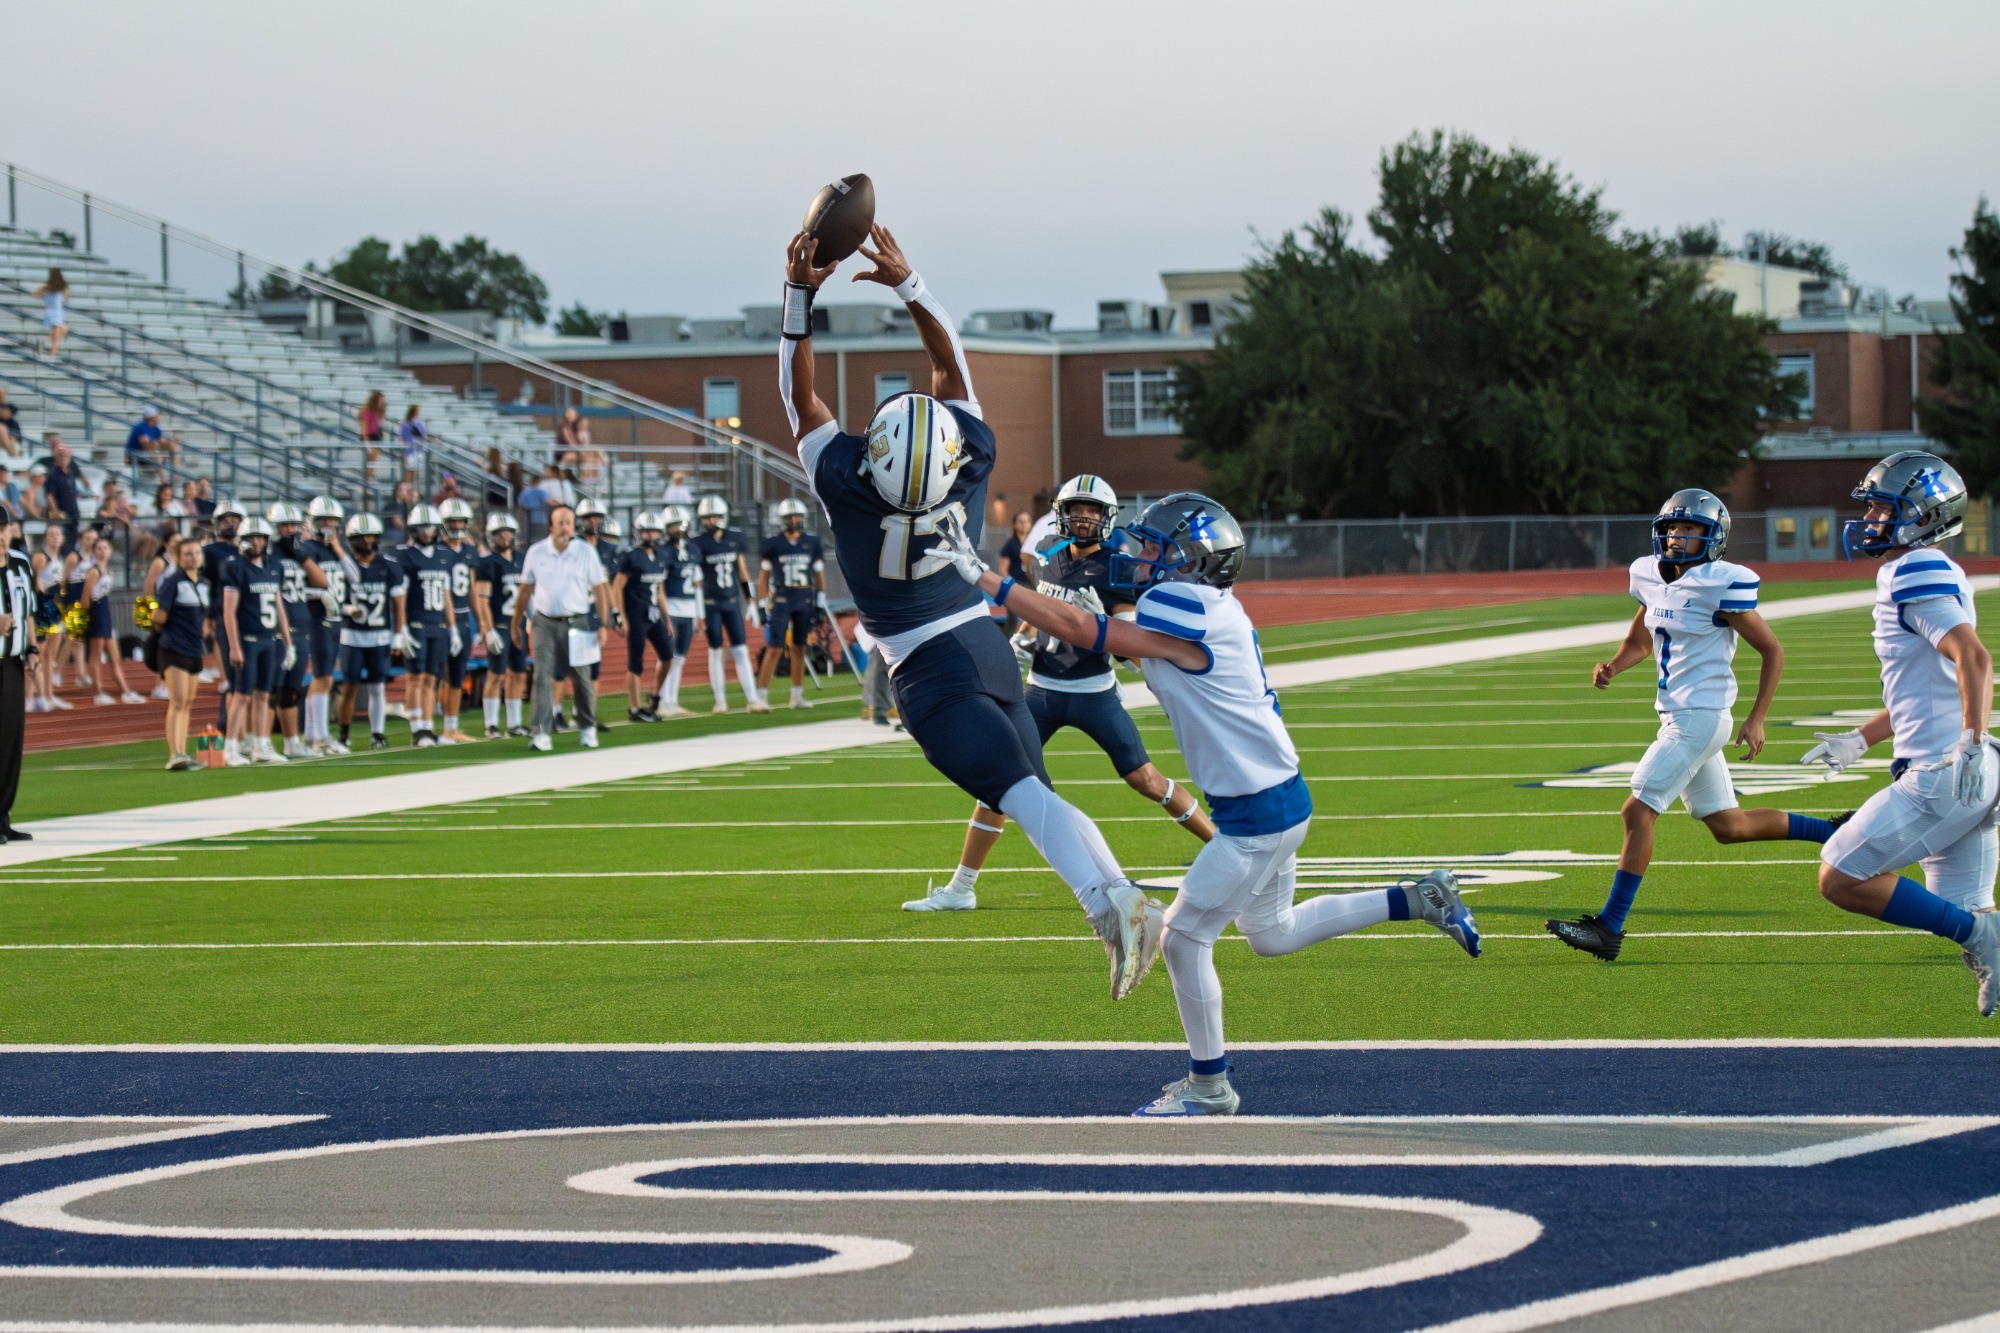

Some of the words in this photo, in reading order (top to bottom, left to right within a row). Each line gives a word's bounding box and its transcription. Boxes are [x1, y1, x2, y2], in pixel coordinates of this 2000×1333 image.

[869, 420, 890, 463] 12
[421, 580, 445, 611] 10
[452, 563, 469, 597] 6
[260, 593, 277, 629] 5
[1422, 889, 1449, 910] NIKE
